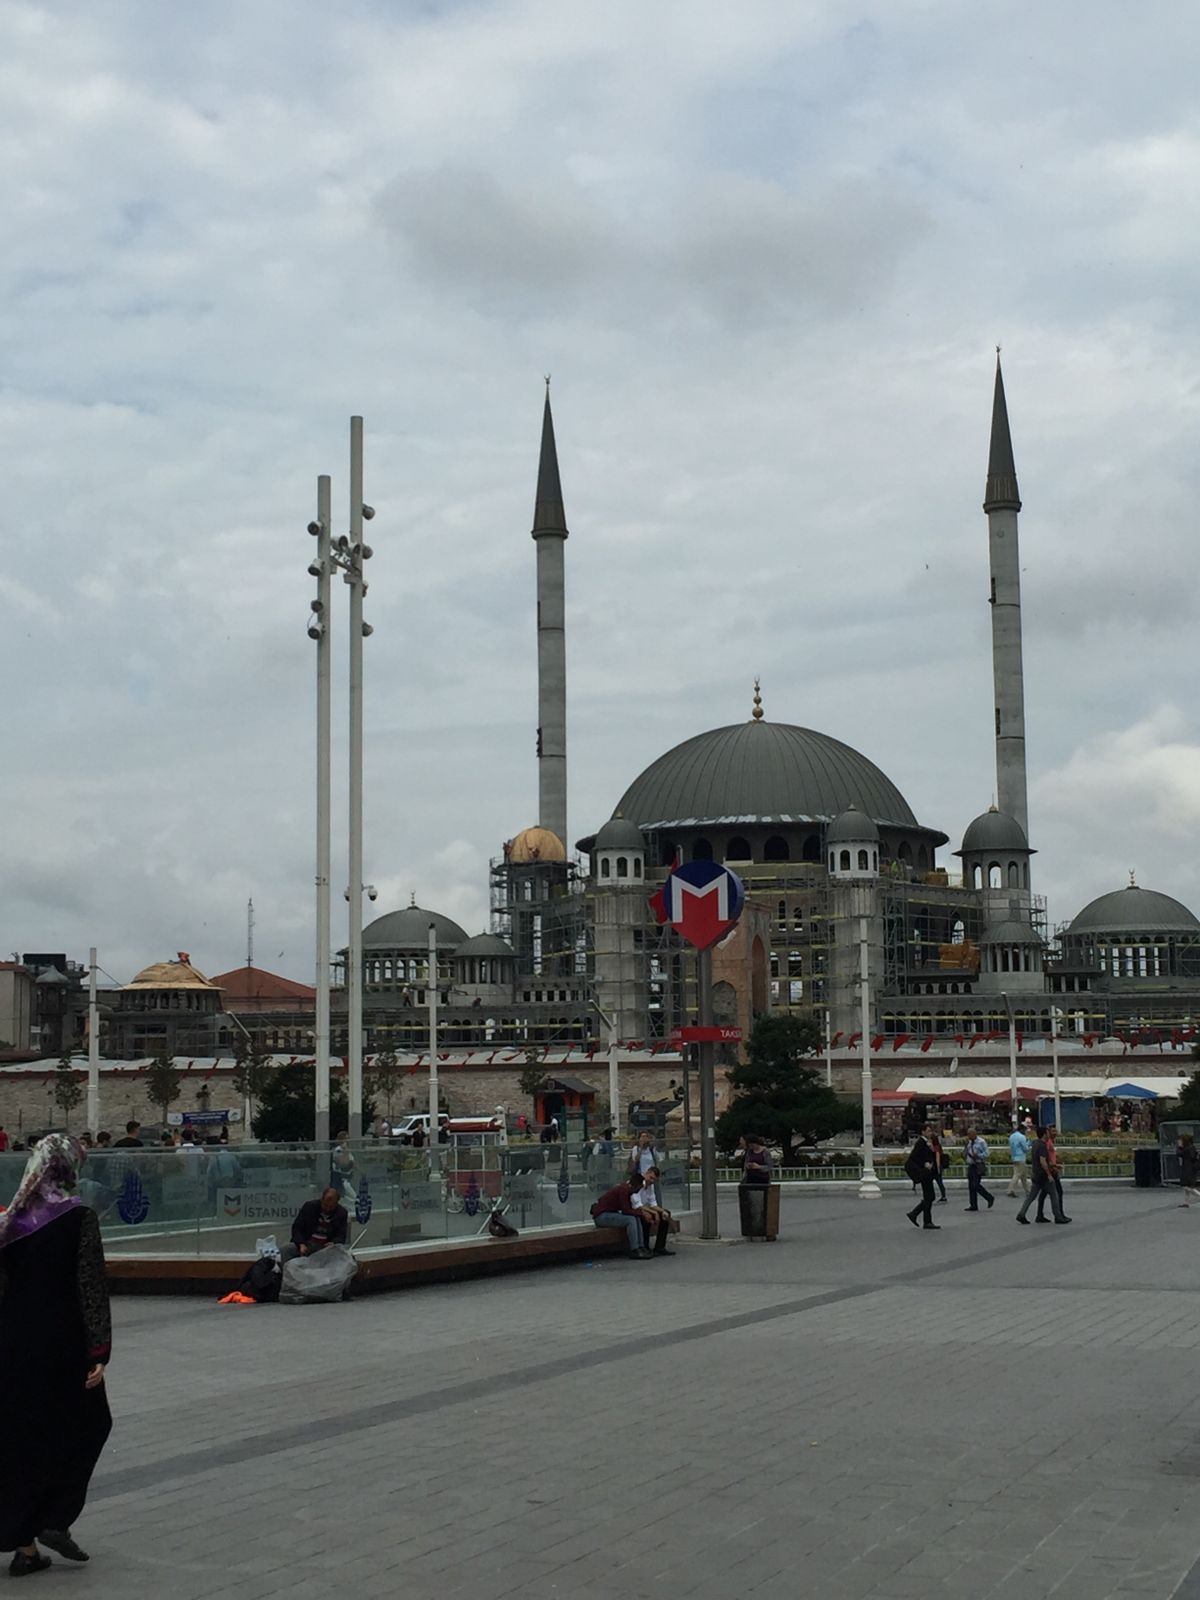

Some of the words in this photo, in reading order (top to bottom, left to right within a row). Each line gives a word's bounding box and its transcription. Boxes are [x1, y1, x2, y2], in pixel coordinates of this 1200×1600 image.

[671, 872, 729, 923] M
[720, 1029, 741, 1038] TAKS
[243, 1192, 288, 1204] METRO
[244, 1205, 301, 1218] İSTANBU
